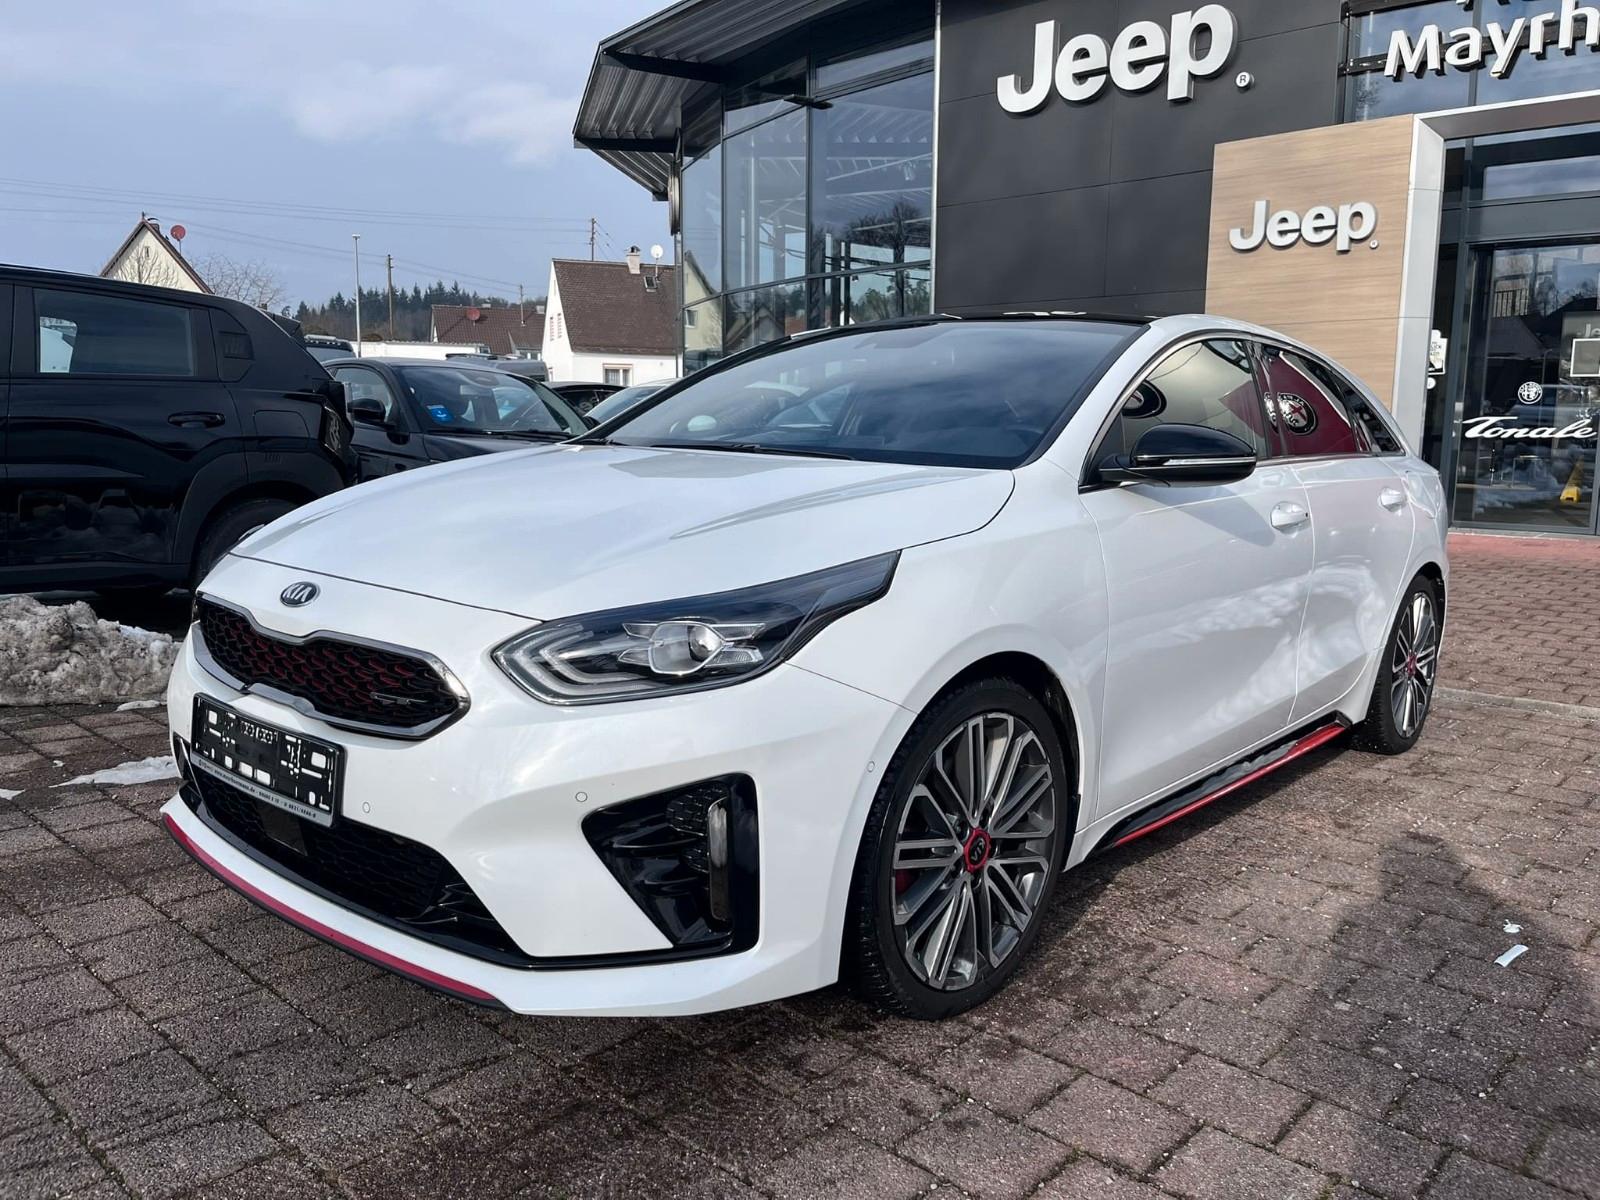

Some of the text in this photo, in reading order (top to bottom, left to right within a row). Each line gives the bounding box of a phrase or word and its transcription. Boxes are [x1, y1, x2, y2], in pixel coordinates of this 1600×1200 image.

[997, 4, 1238, 115] Jeep
[1229, 200, 1378, 253] Jeep
[1461, 416, 1598, 439] Tonale
[282, 583, 313, 602] KIA
